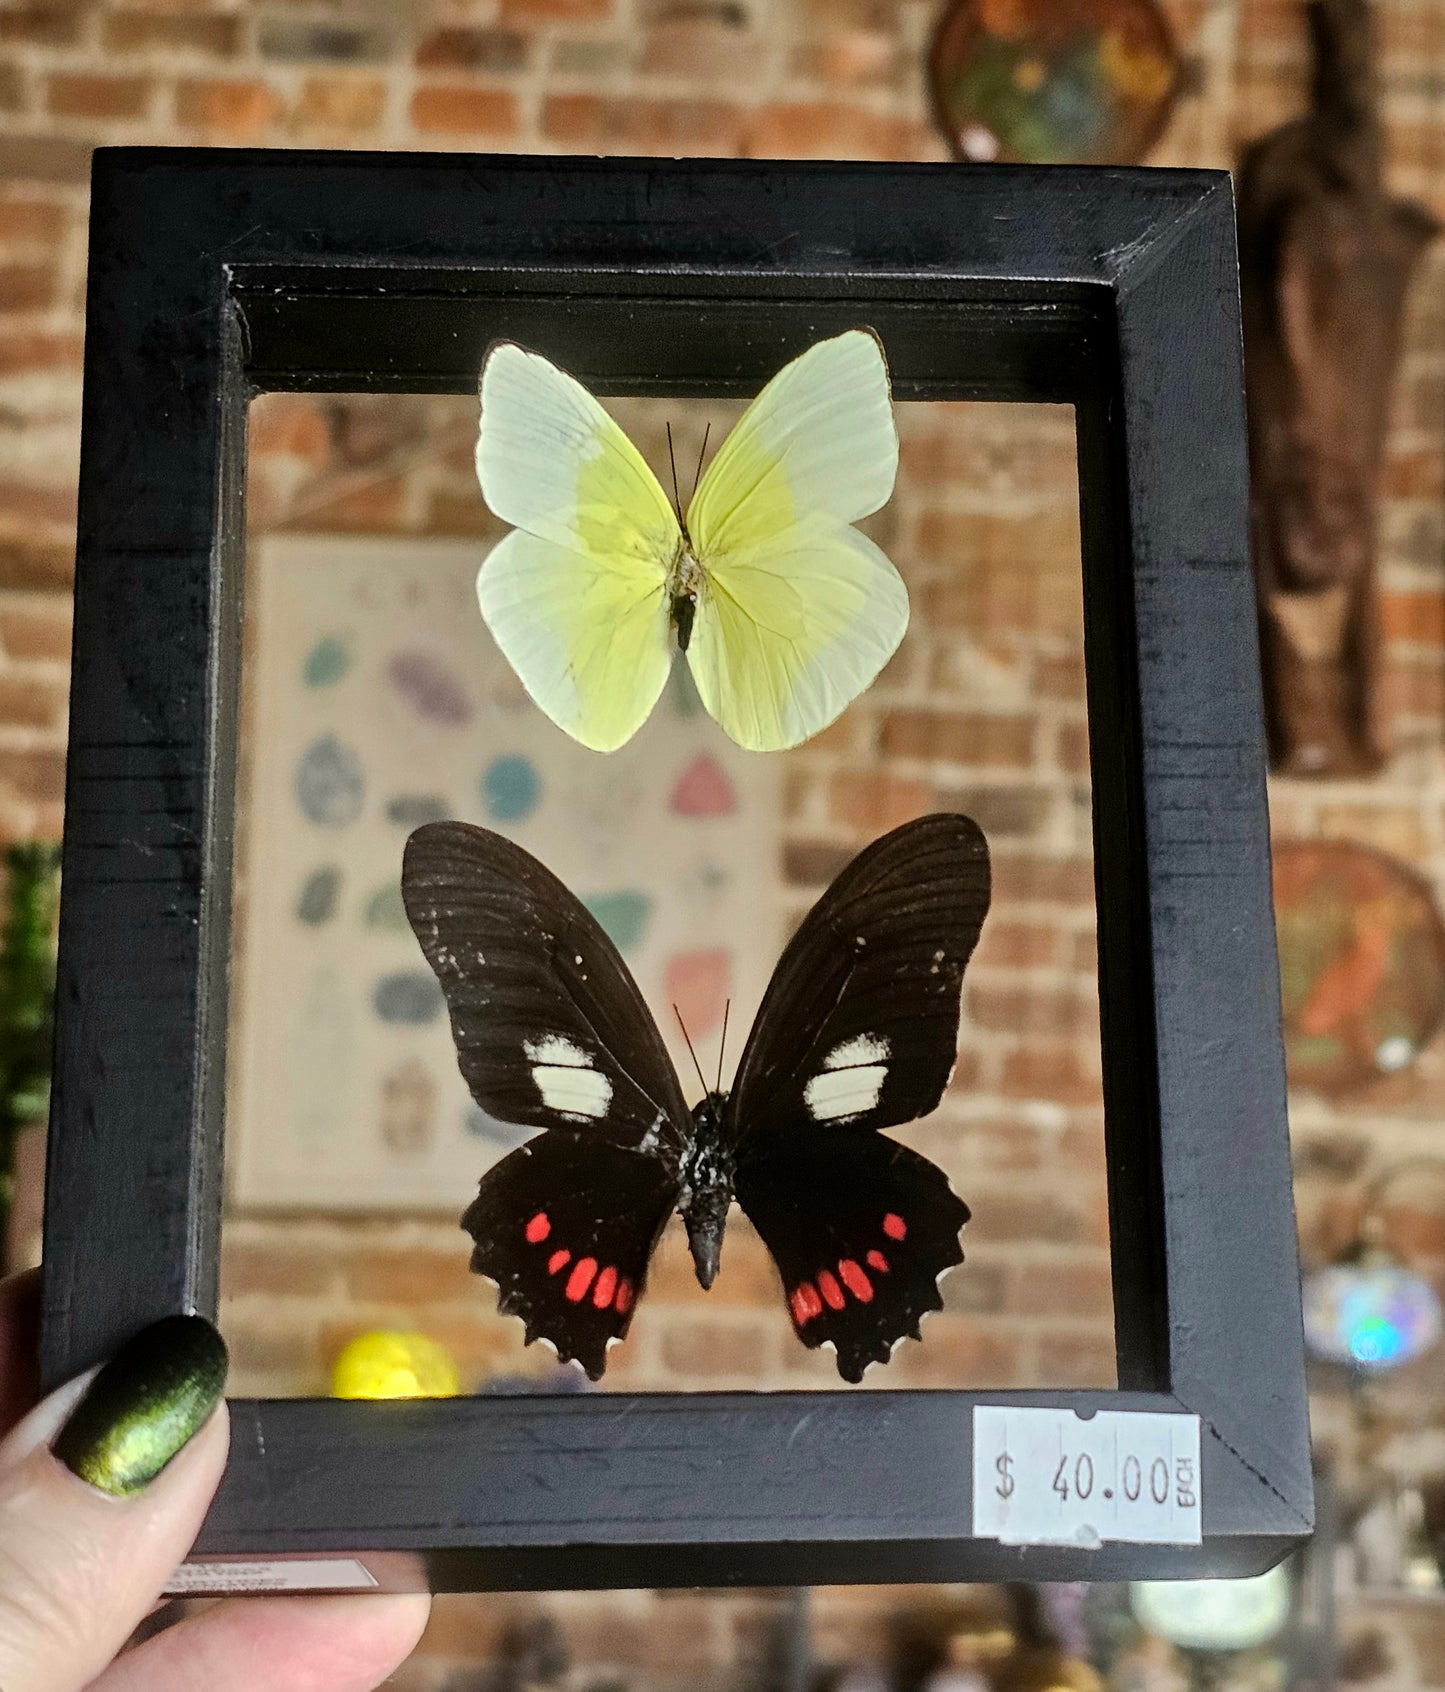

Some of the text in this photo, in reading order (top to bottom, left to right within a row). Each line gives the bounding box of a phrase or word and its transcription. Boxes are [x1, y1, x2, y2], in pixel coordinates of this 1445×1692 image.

[995, 1451, 1169, 1504] $ 40.00
[1176, 1457, 1196, 1508] EACH
